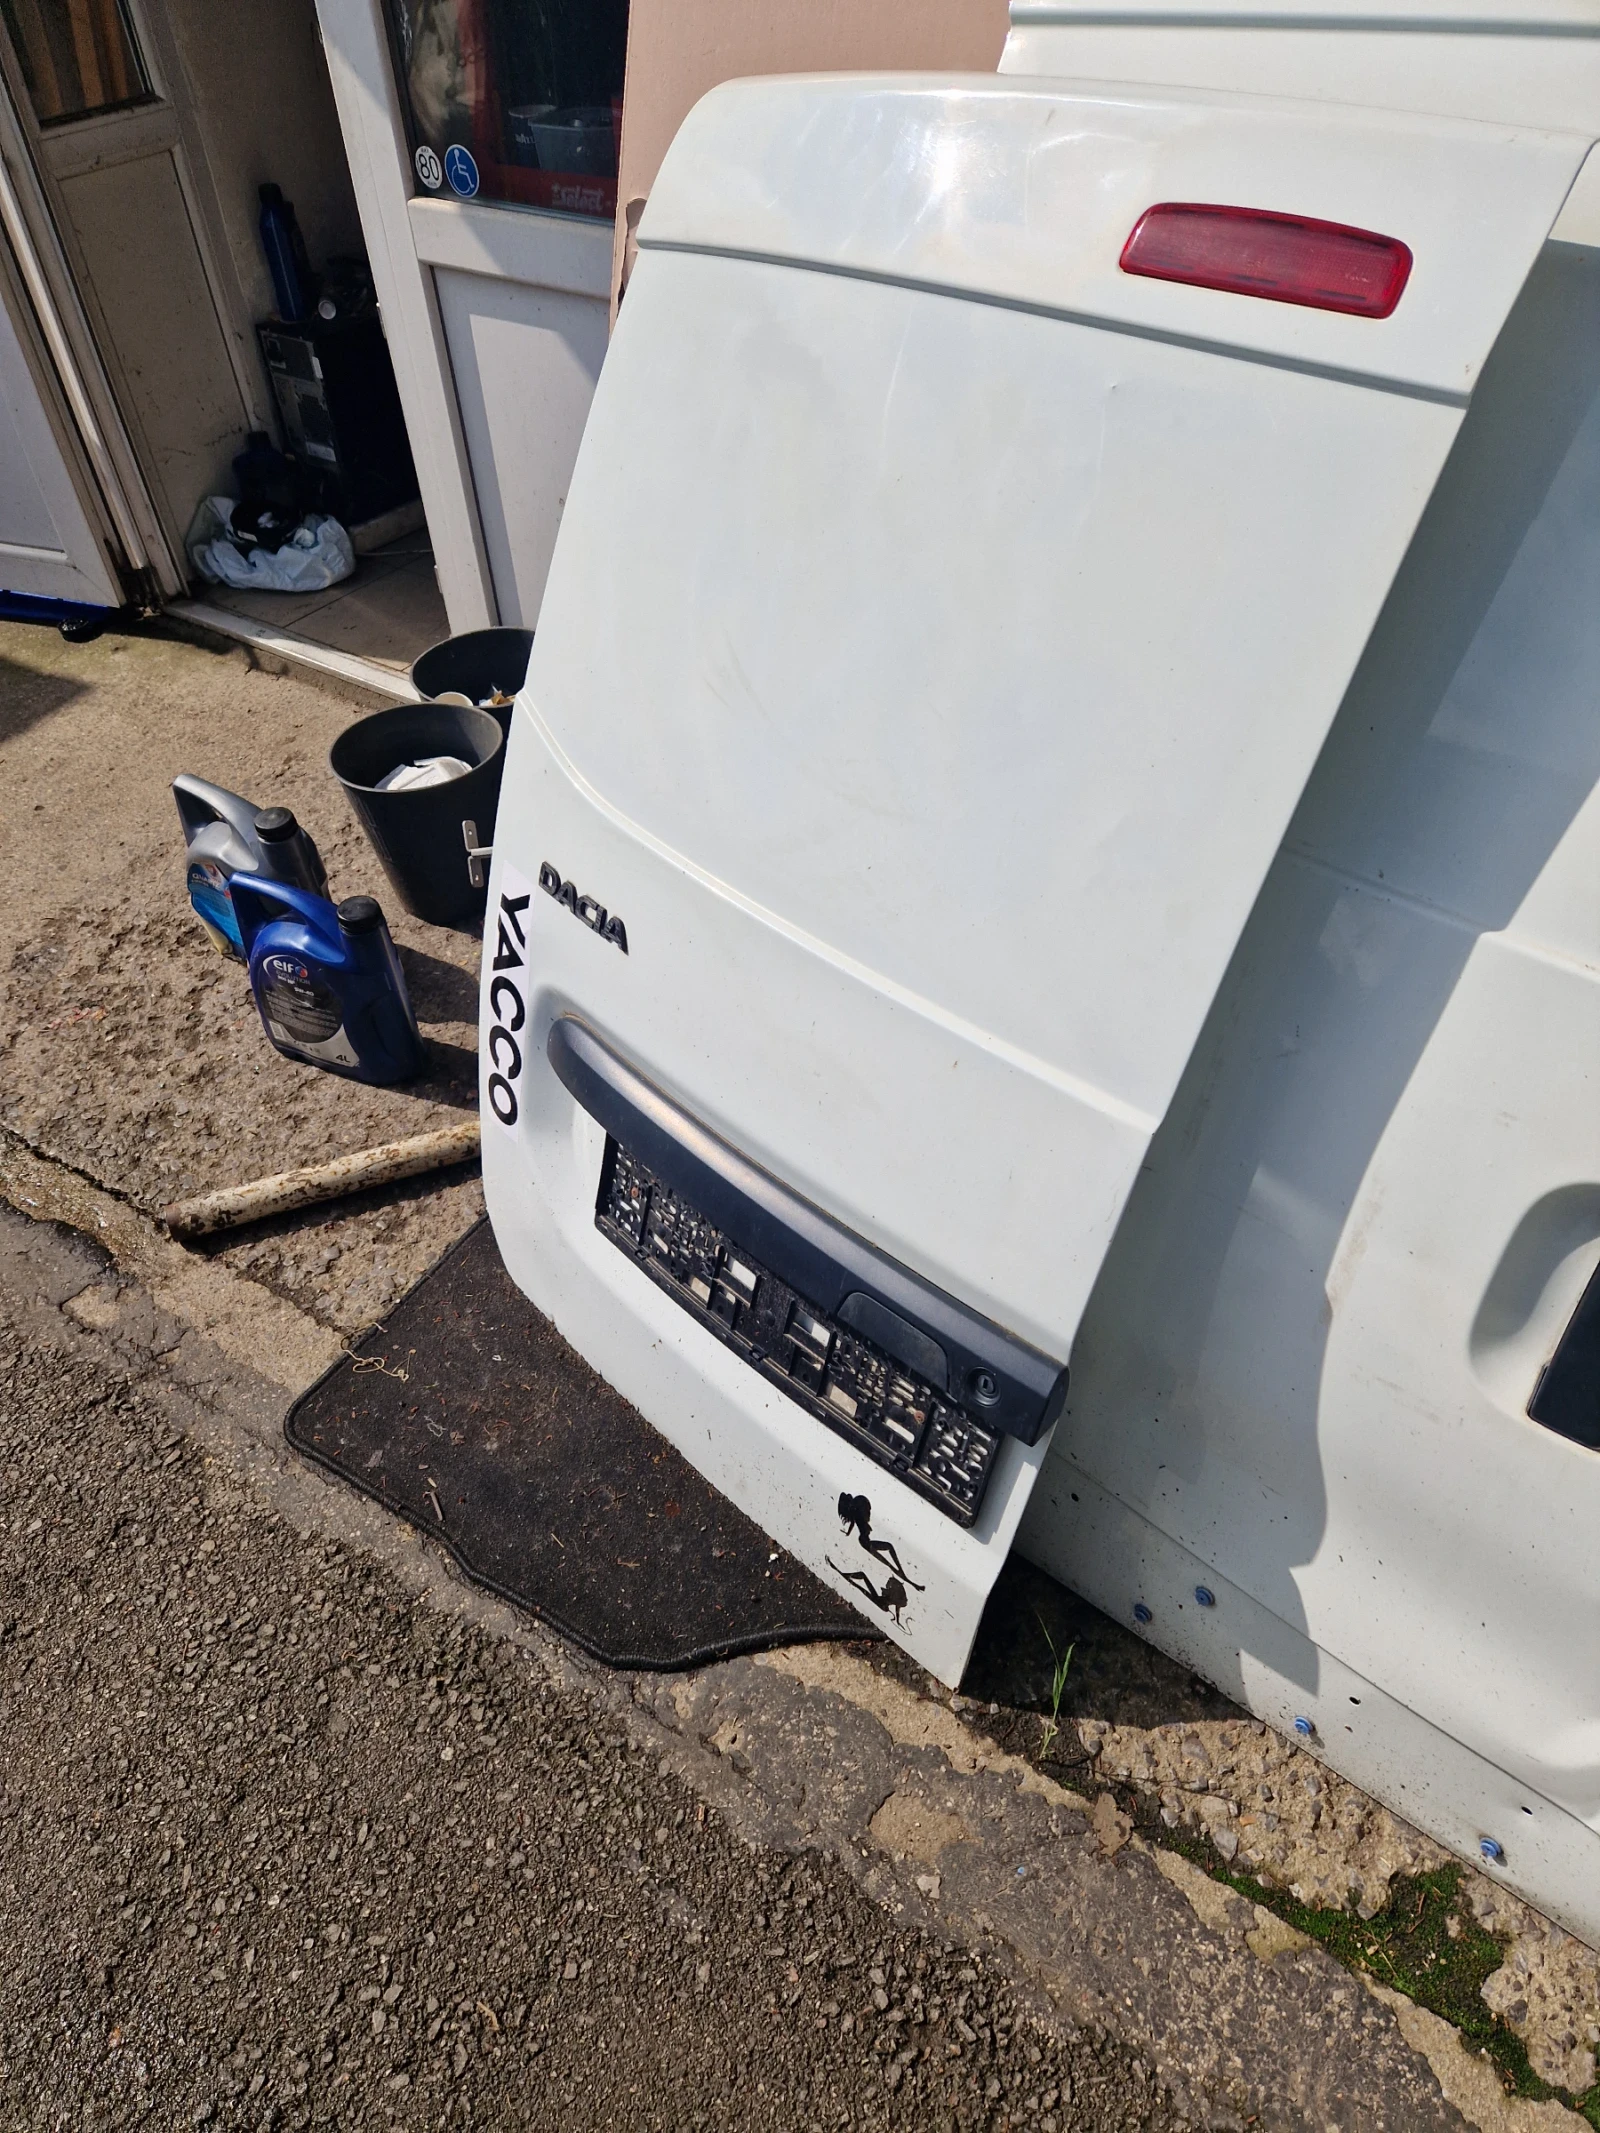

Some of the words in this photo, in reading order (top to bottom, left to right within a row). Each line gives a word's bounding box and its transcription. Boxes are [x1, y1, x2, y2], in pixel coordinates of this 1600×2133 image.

[419, 154, 440, 181] 80
[538, 860, 629, 956] DACIA
[273, 959, 294, 973] elf
[488, 893, 531, 1126] YACCO
[335, 1054, 351, 1064] 4L
